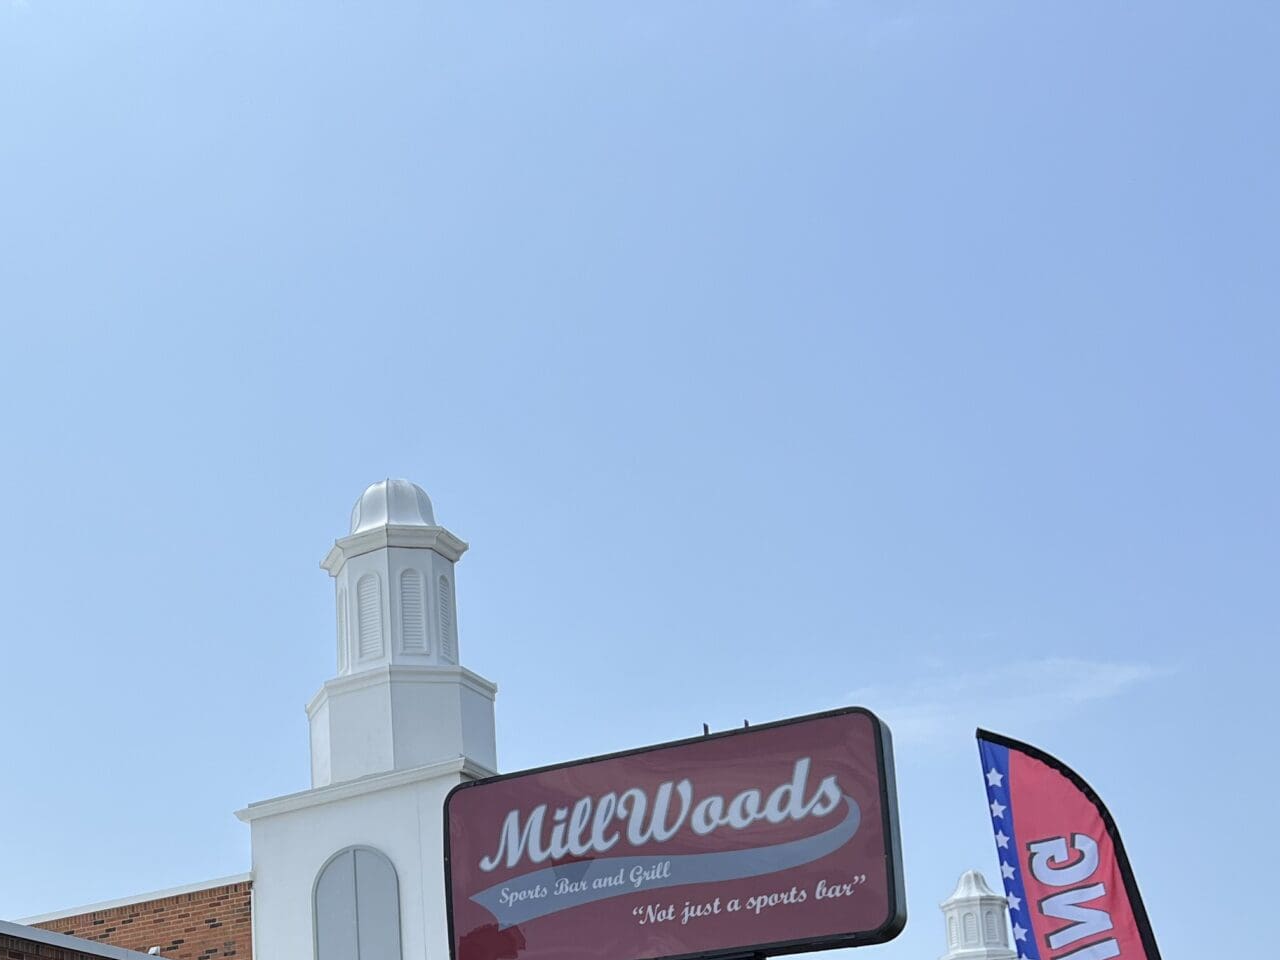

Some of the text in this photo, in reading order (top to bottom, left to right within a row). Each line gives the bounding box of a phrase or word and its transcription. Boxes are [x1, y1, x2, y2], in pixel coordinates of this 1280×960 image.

[479, 757, 841, 871] MillWoods
[498, 861, 672, 907] Sports Bar and Grill
[681, 894, 721, 924] just
[726, 898, 741, 911] a
[746, 886, 808, 914] sports
